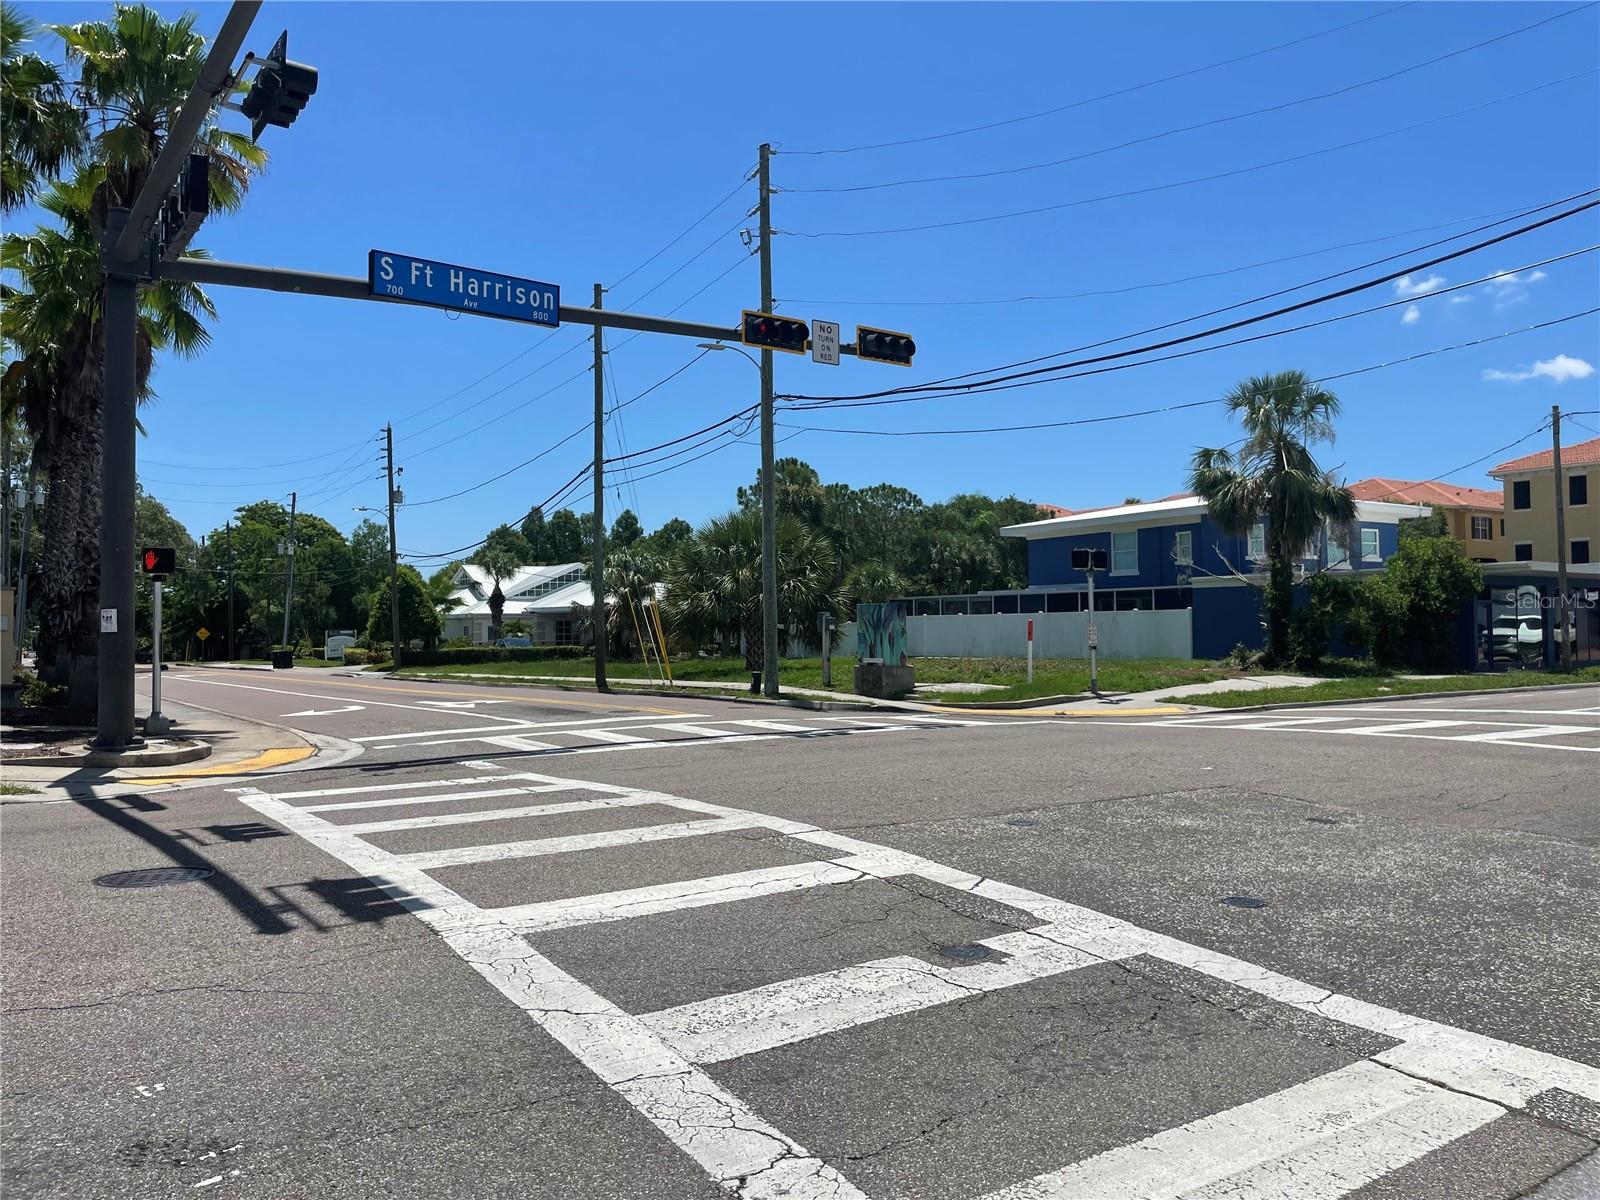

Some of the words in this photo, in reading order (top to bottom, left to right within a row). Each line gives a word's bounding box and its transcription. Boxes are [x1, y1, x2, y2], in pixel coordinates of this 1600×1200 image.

[380, 256, 394, 280] S
[411, 262, 433, 287] Ft
[450, 269, 554, 310] Harrison
[386, 284, 404, 296] 700
[463, 298, 478, 309] Ave
[533, 311, 549, 321] 800
[819, 325, 832, 334] NO
[818, 335, 834, 343] TURN
[821, 344, 831, 352] ON
[820, 353, 832, 361] RED
